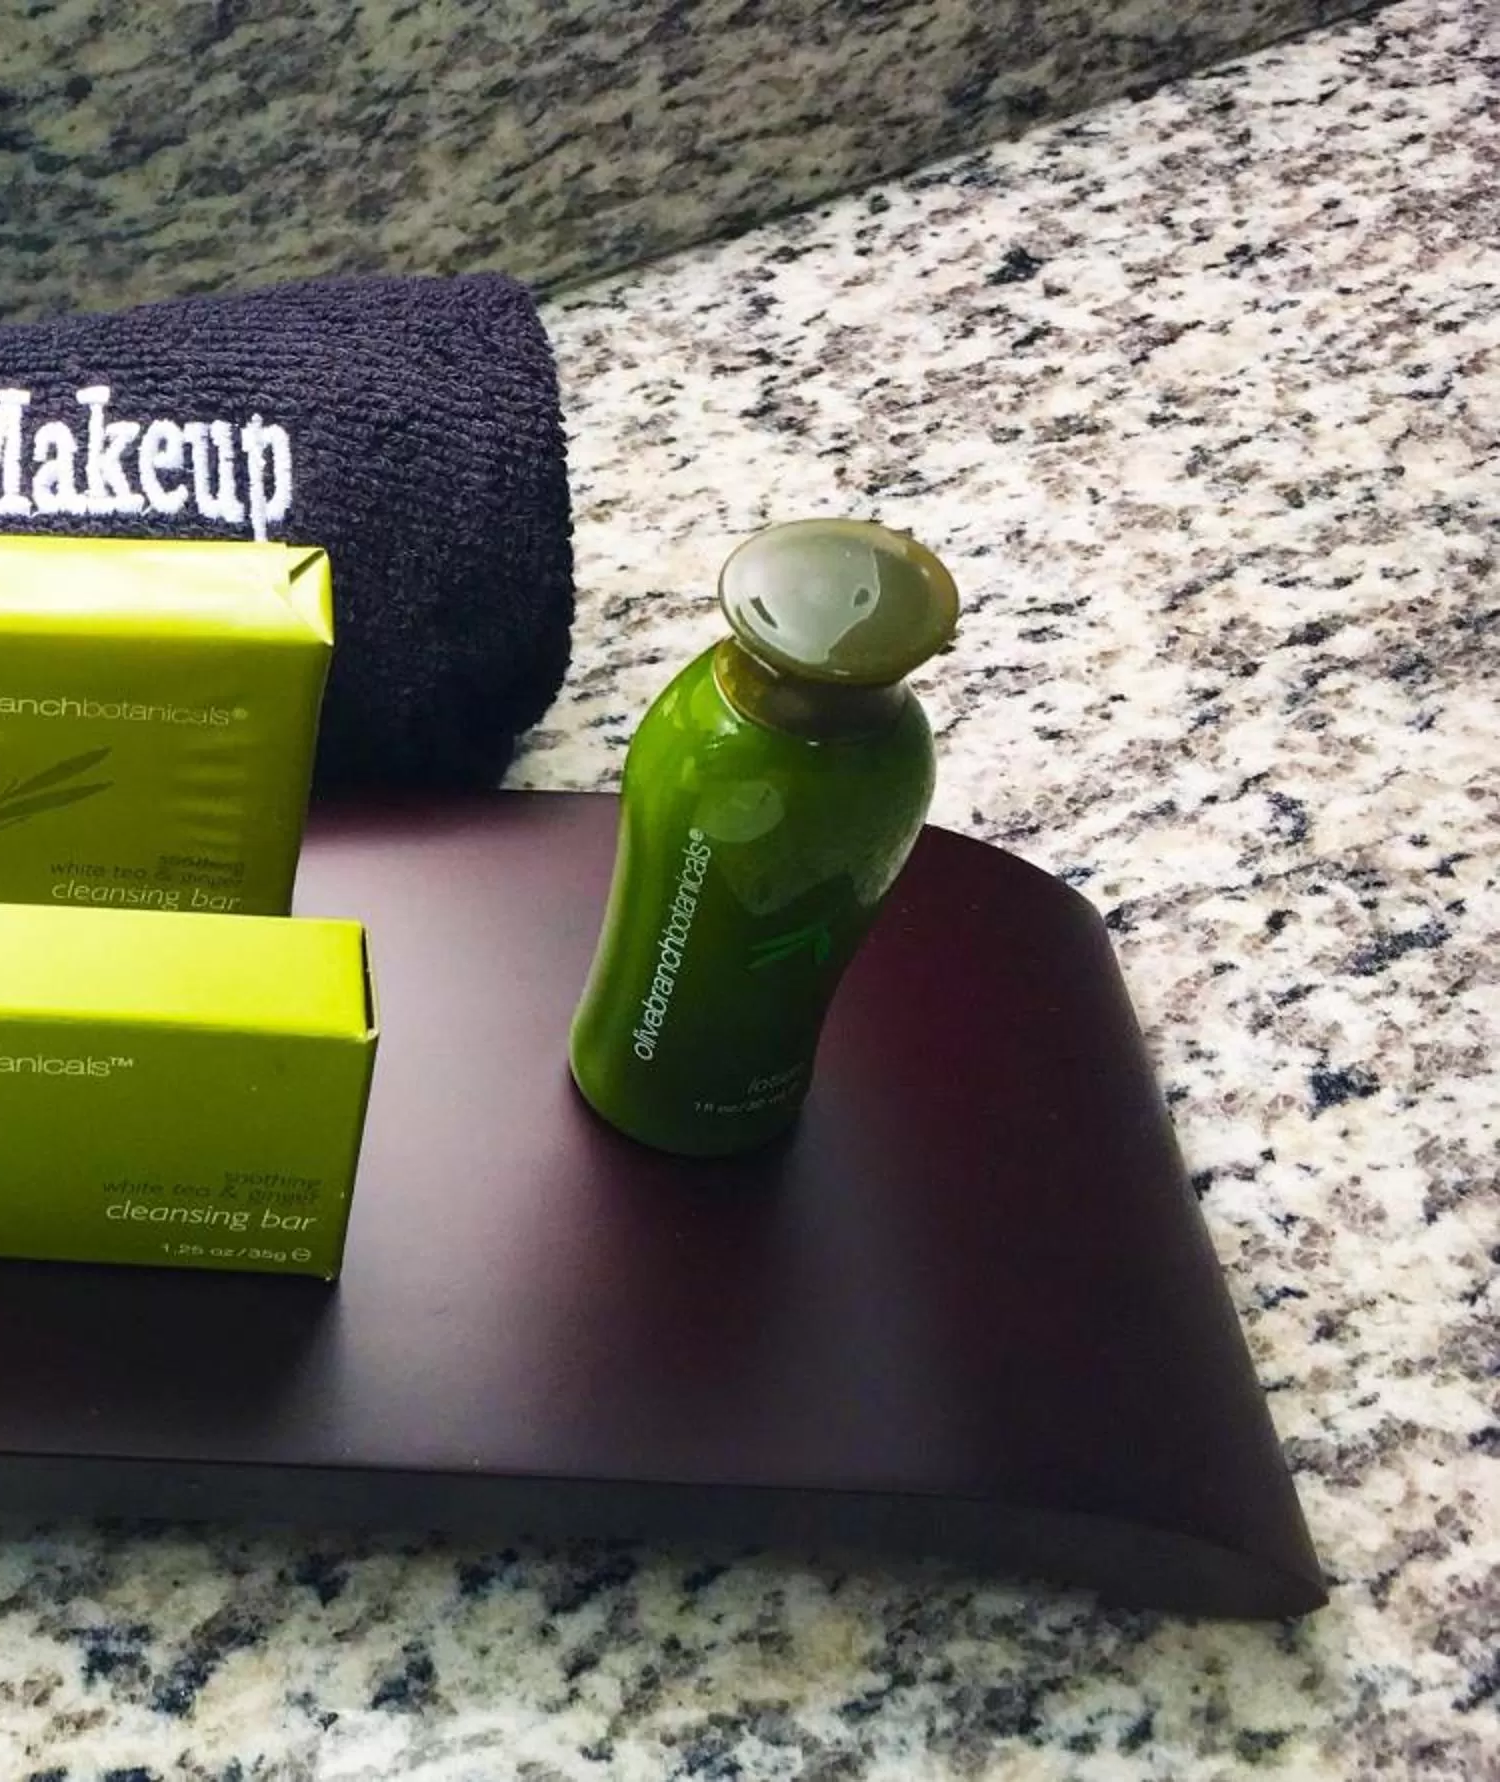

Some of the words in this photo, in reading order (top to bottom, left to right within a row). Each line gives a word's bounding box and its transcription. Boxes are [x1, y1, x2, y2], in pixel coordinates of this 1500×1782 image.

[51, 879, 182, 911] cleansing
[190, 887, 242, 912] bar
[103, 1180, 165, 1196] white
[105, 1199, 253, 1232] cleansing
[260, 1207, 318, 1232] bar
